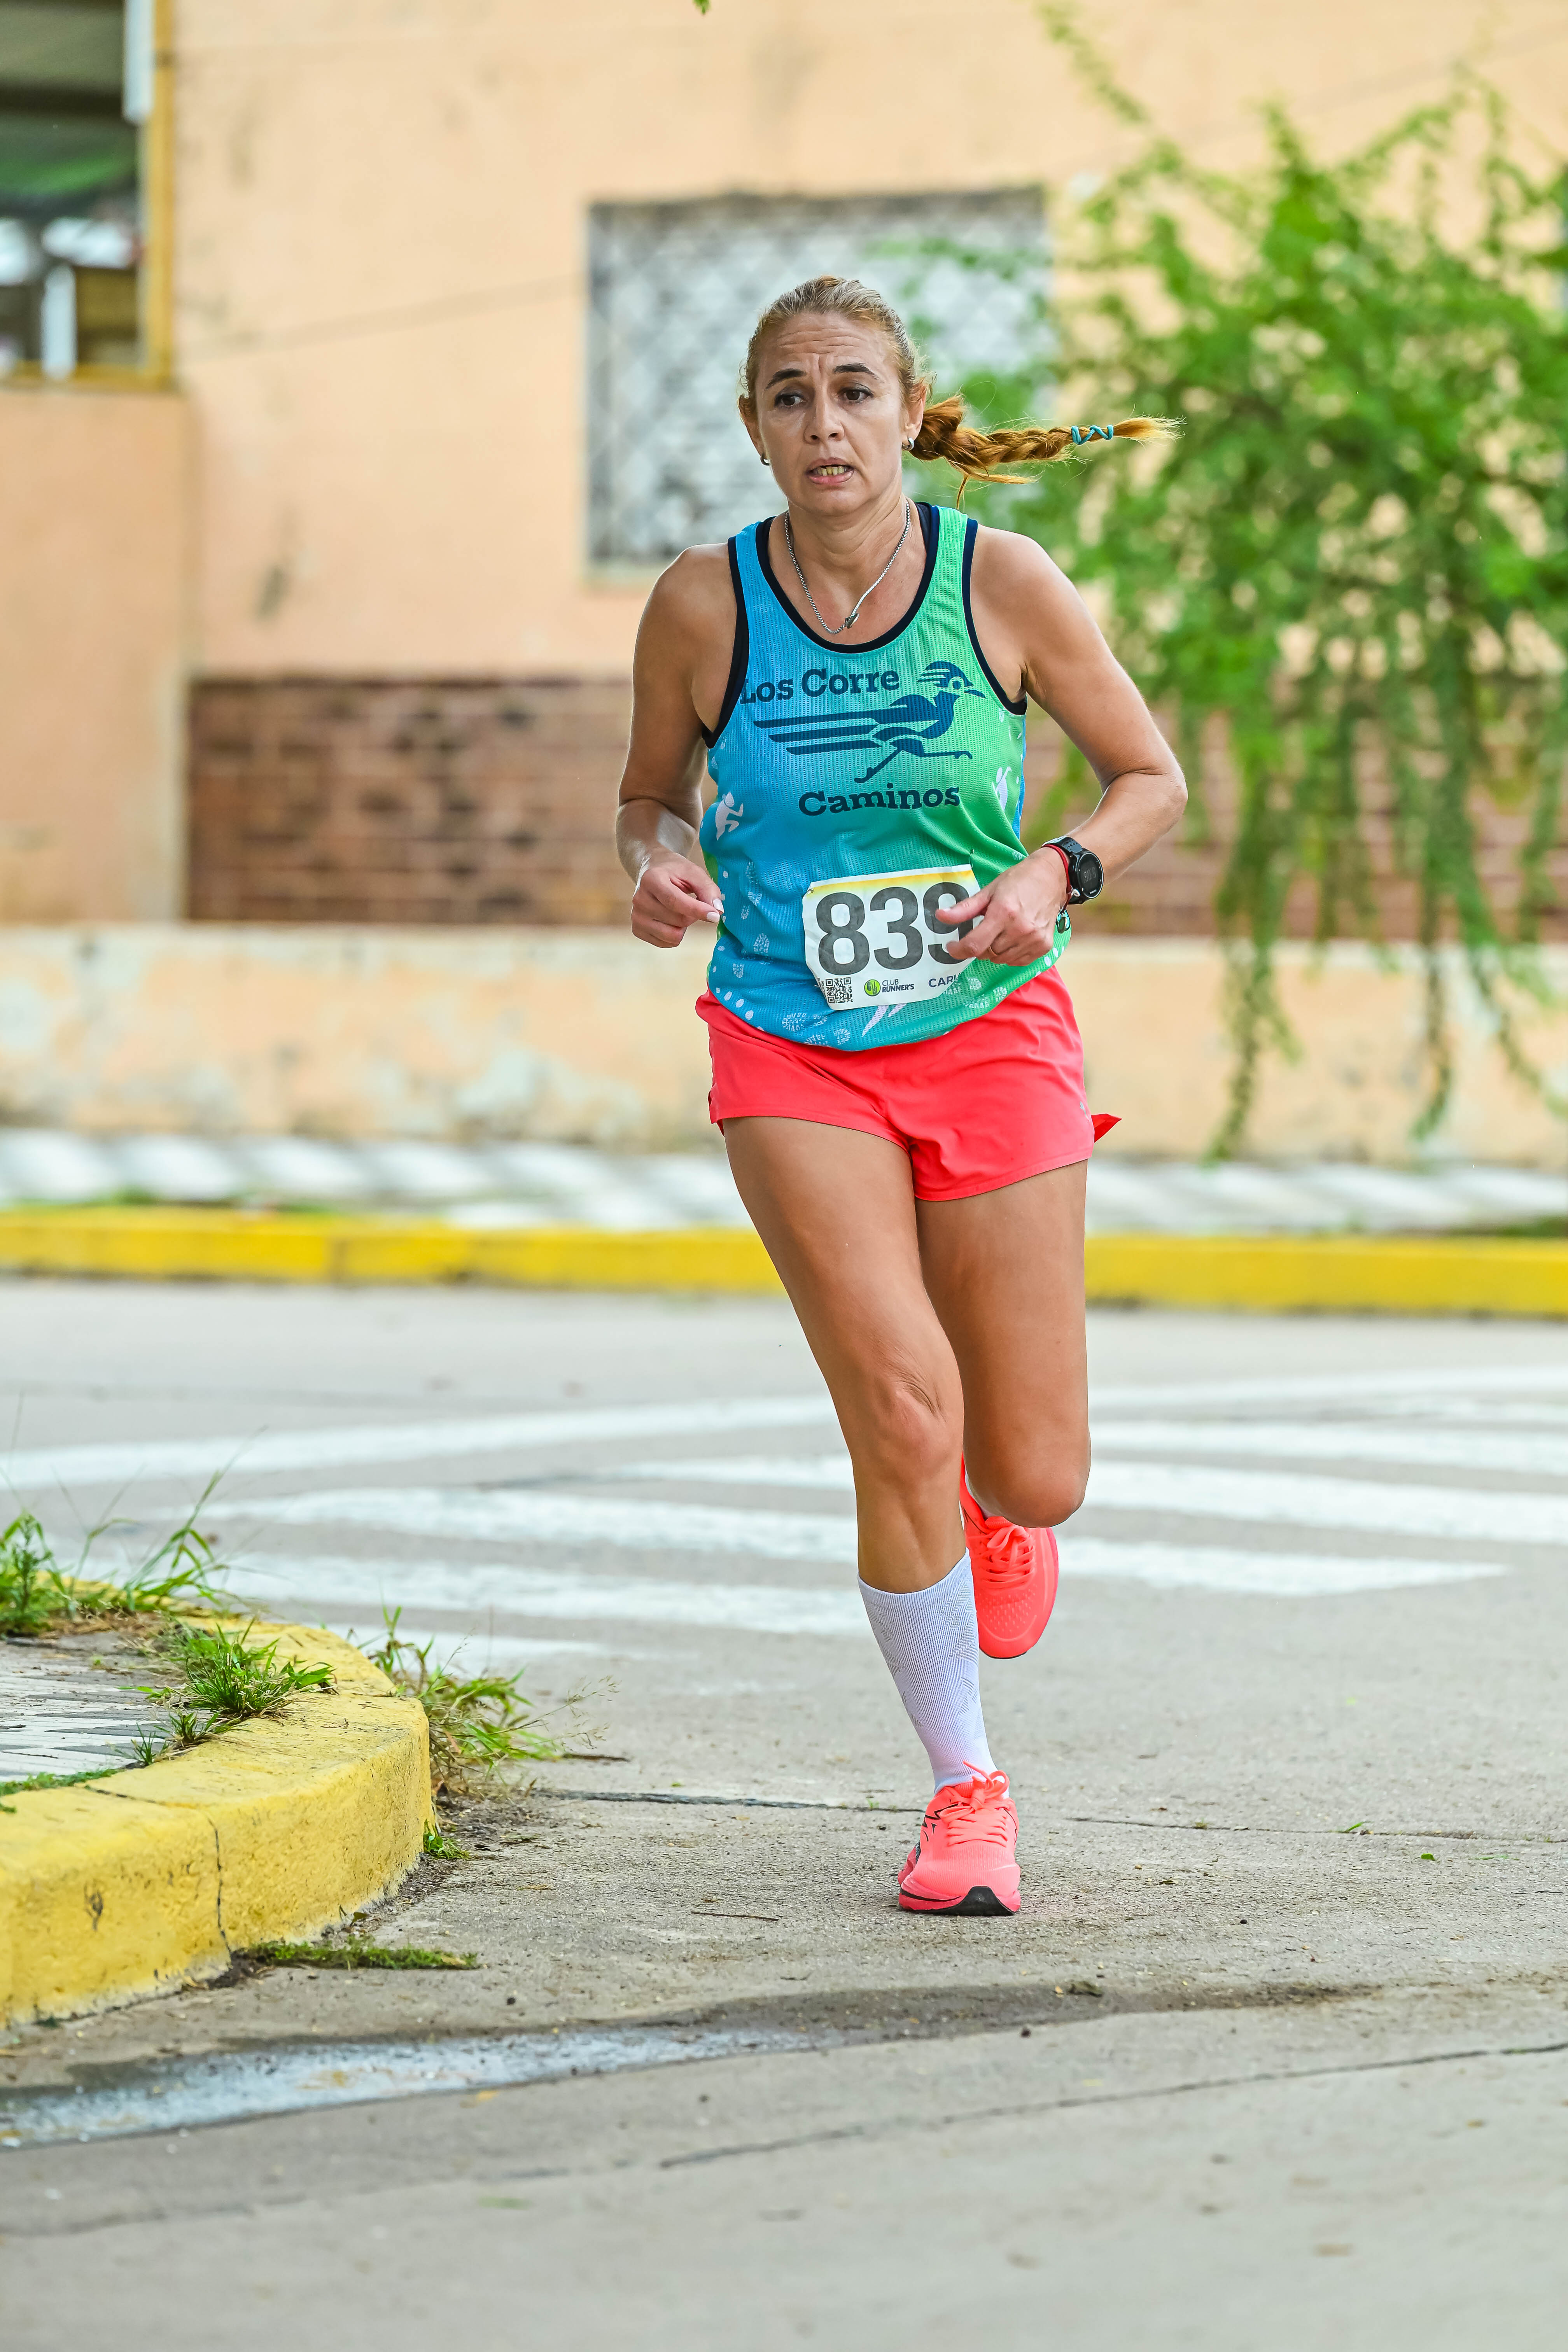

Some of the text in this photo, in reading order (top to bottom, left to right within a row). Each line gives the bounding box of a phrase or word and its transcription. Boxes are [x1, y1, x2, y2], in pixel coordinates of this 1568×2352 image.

[740, 668, 900, 704] Los Corre
[798, 783, 960, 816] Caminos
[816, 882, 973, 975] 839
[882, 984, 914, 992] RUNNER'S
